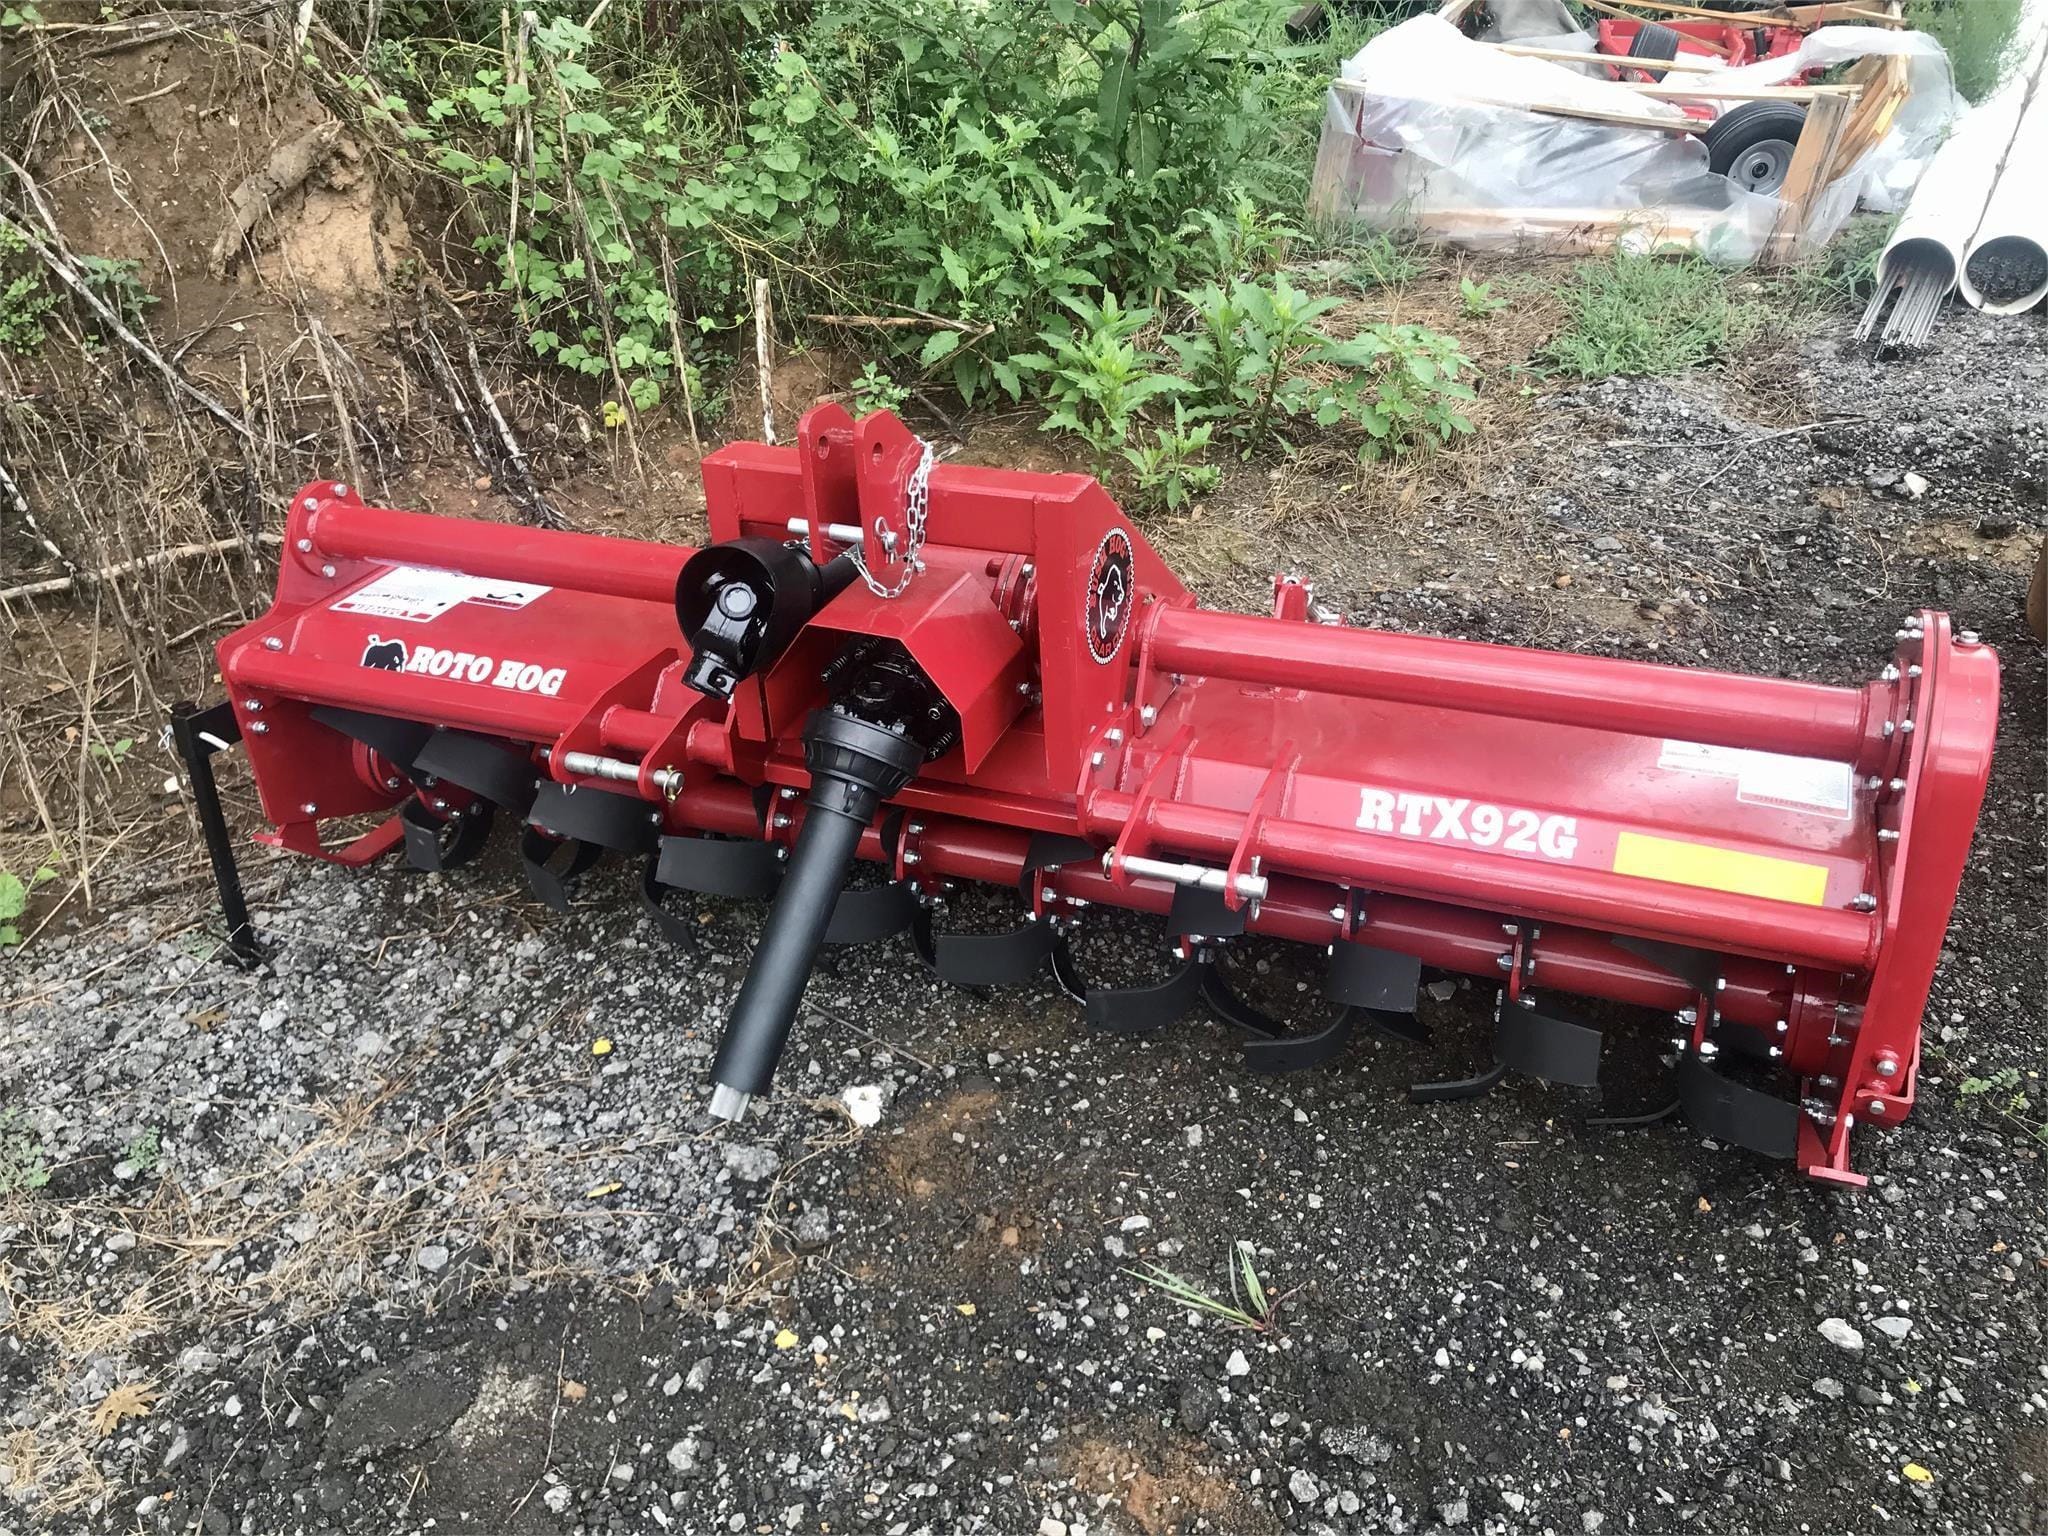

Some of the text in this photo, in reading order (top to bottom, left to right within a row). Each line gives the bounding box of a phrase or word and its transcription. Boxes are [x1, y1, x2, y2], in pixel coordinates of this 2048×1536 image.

[1090, 535, 1127, 608] BUSH HOG
[406, 646, 568, 696] ROTO HOG
[1091, 626, 1112, 656] GEAR
[1355, 788, 1578, 860] RTX92G
